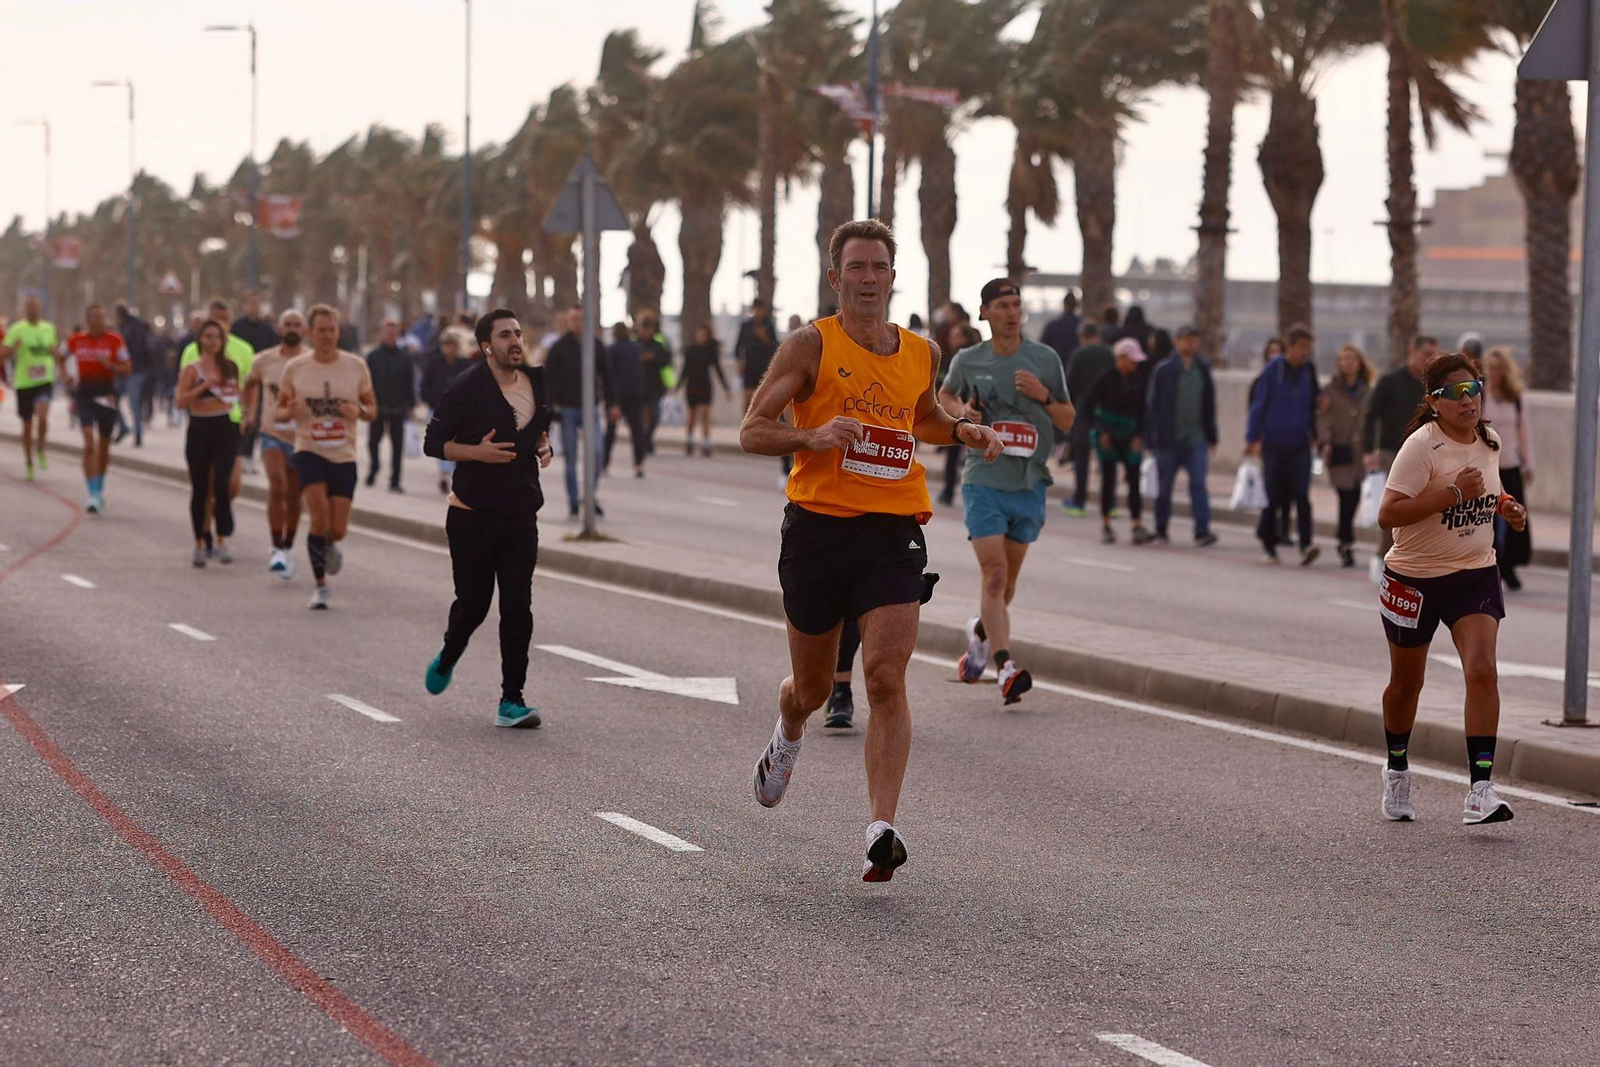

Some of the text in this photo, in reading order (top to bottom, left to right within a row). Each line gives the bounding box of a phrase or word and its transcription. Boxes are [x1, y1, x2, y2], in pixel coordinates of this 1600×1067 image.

[843, 391, 911, 420] parkrun
[881, 446, 910, 460] 1536
[1441, 511, 1477, 531] RUN
[1391, 594, 1418, 612] 1599
